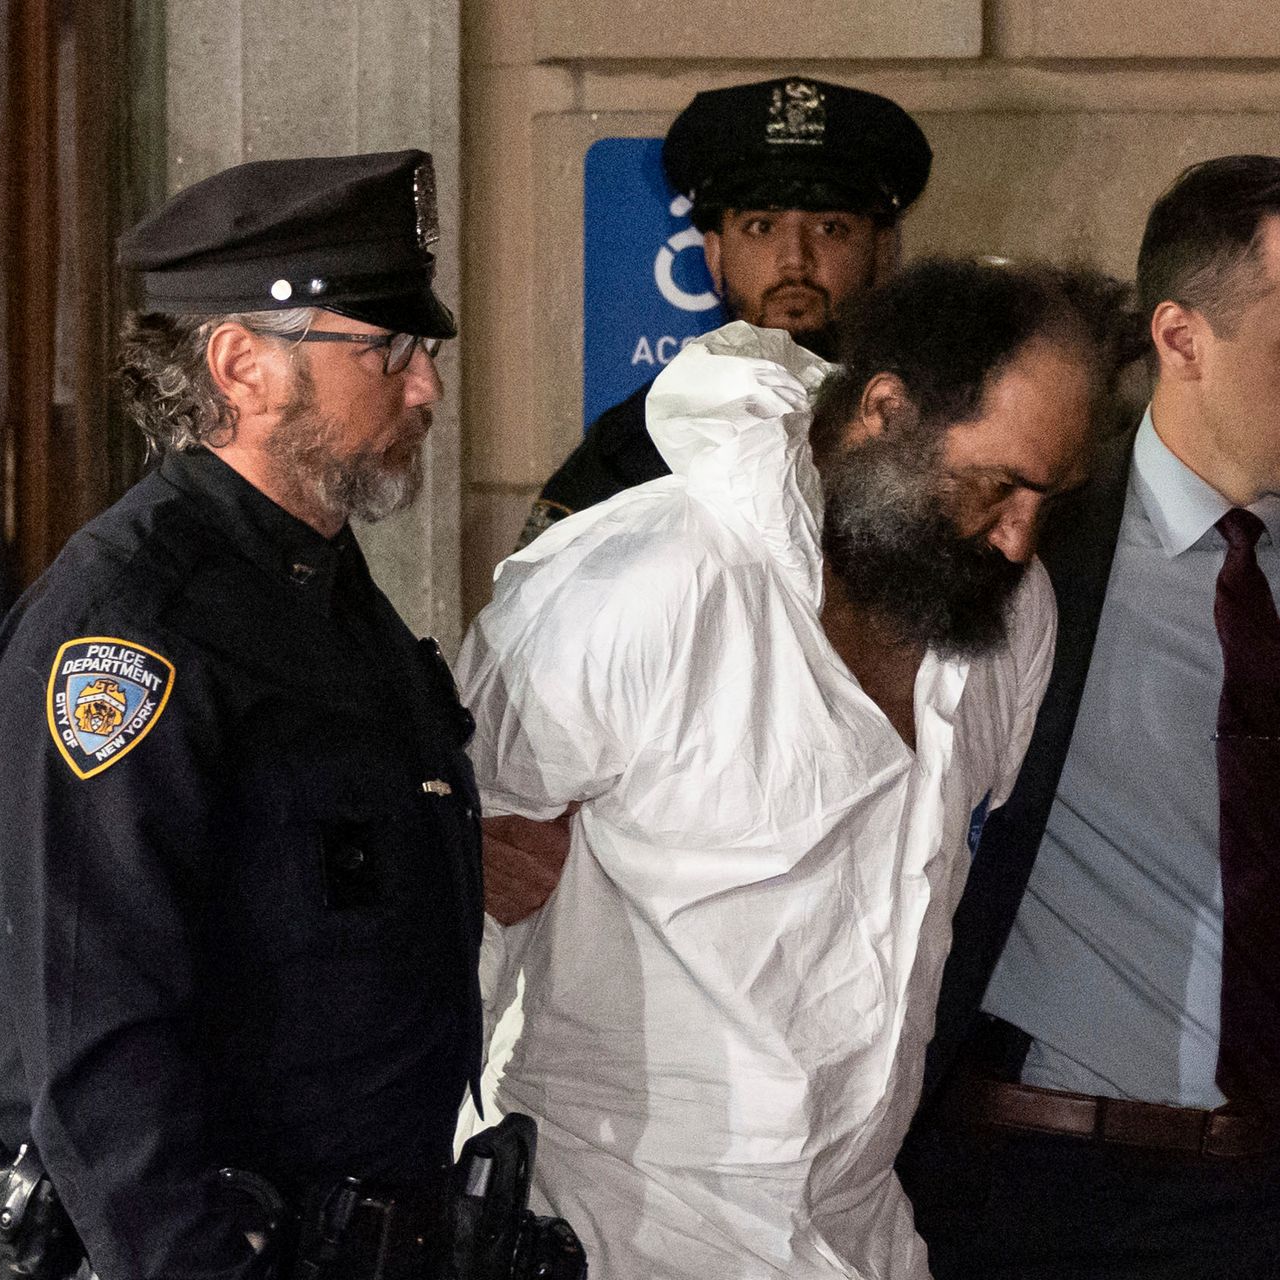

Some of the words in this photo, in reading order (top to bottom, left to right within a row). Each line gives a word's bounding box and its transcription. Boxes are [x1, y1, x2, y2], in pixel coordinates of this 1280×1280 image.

[87, 645, 146, 668] POLICE
[62, 658, 163, 691] DEPARTMENT
[55, 692, 70, 725] CITY
[62, 729, 79, 749] OF
[95, 734, 126, 761] NEW
[124, 698, 156, 735] YORK
